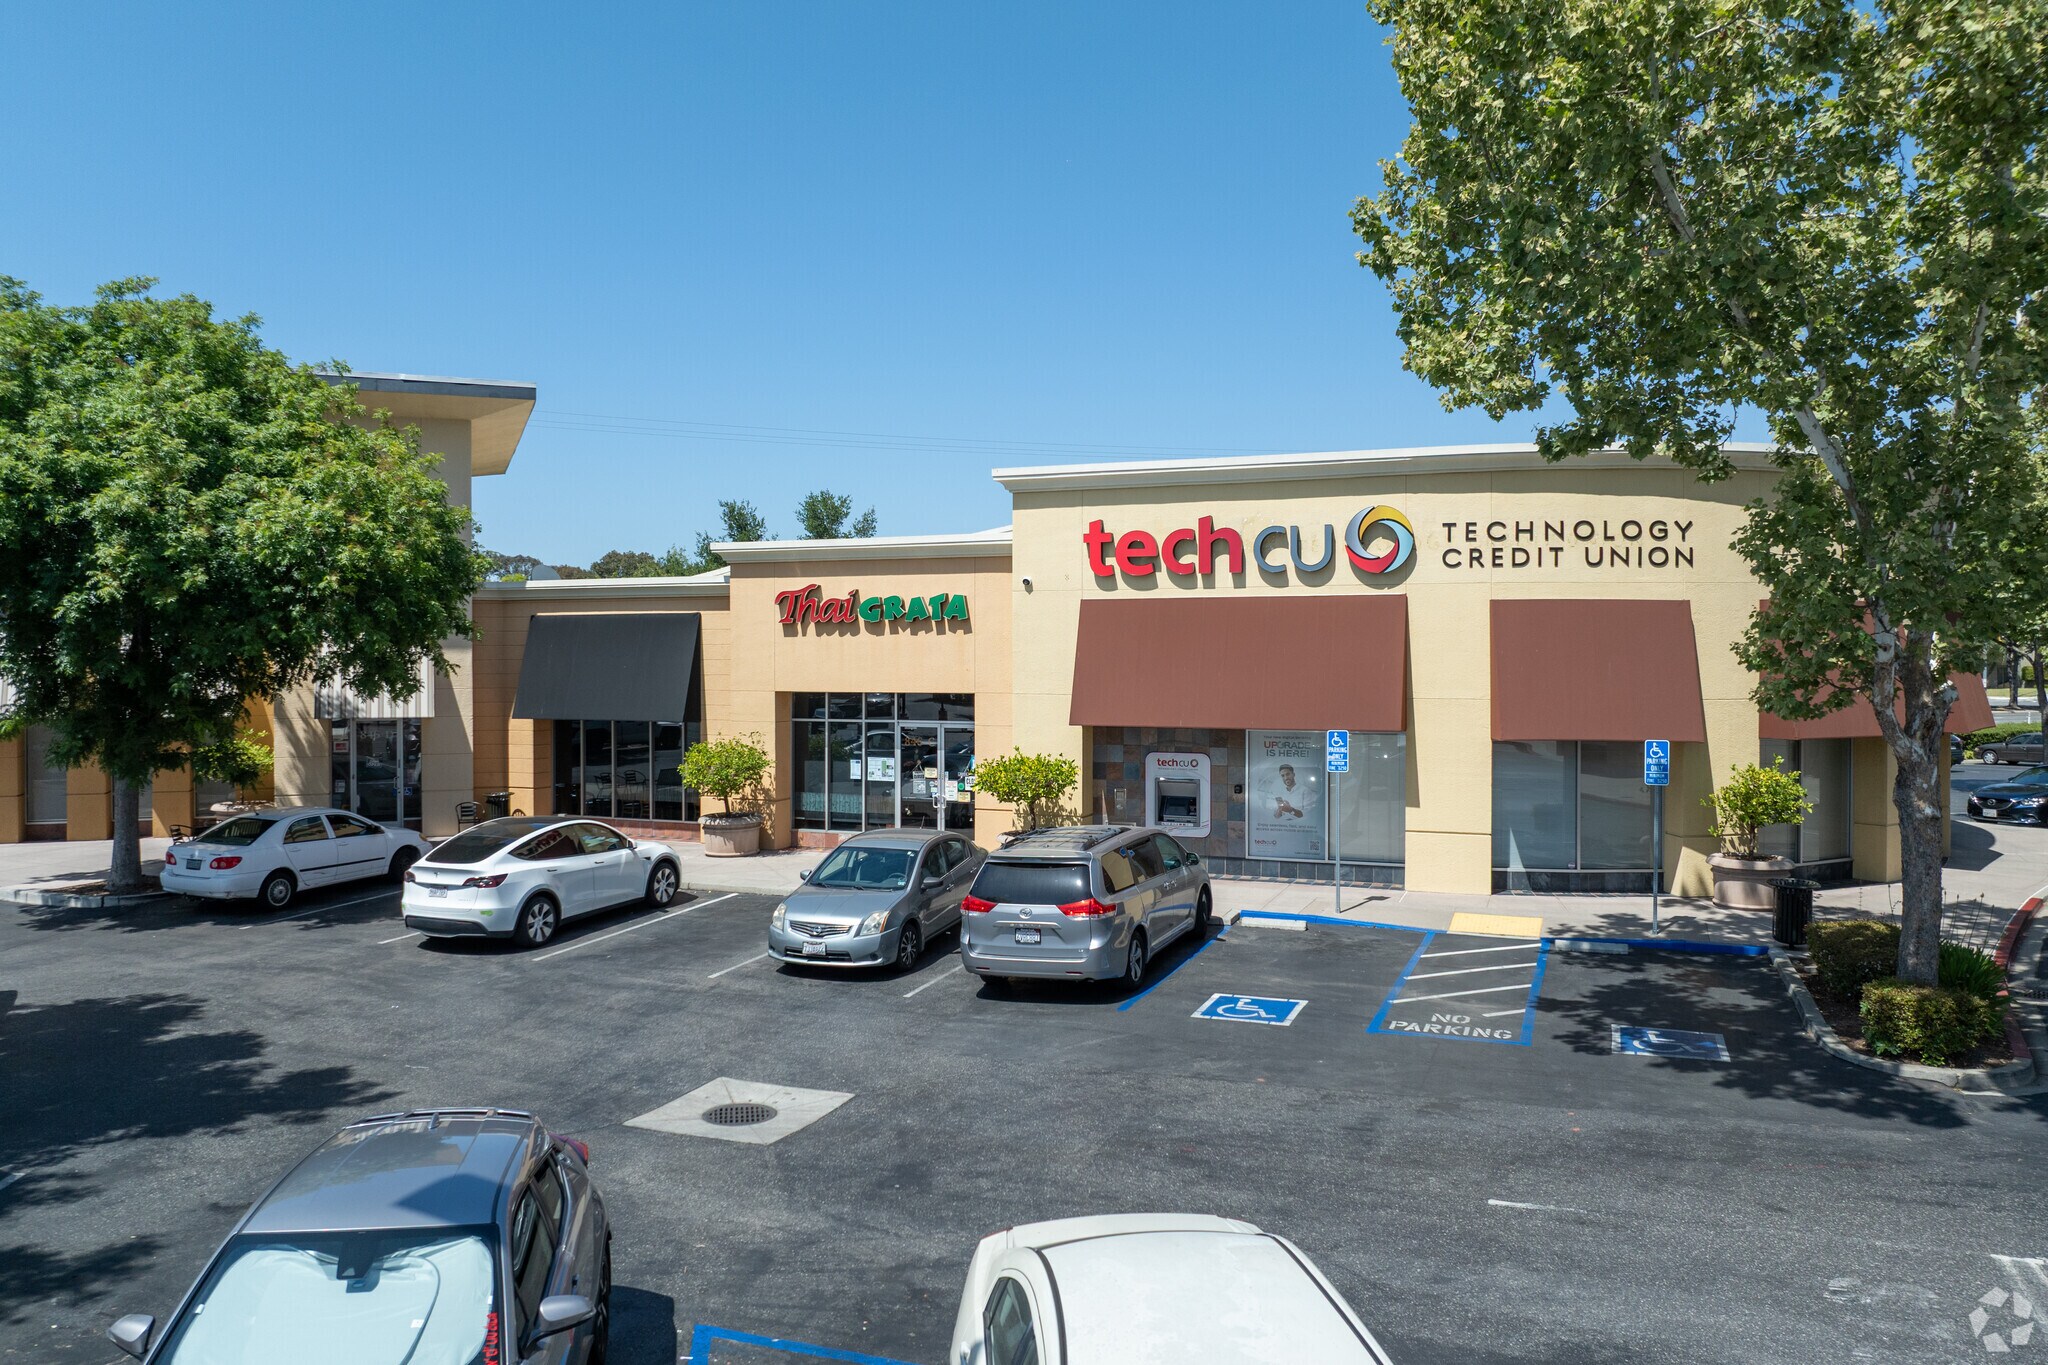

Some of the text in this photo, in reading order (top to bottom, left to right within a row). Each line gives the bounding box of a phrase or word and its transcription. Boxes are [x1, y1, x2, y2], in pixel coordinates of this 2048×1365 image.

[1441, 519, 1694, 543] TECHNOLOGY
[1441, 546, 1694, 569] CREDIT UNION
[774, 583, 969, 625] Thai GRATA
[1263, 740, 1312, 750] UPGRADE
[1266, 749, 1311, 758] IS HERE!
[1646, 757, 1668, 765] PARKING
[1650, 764, 1664, 772] ONLY
[1430, 1012, 1471, 1024] NO
[1388, 1020, 1513, 1039] PARKING
